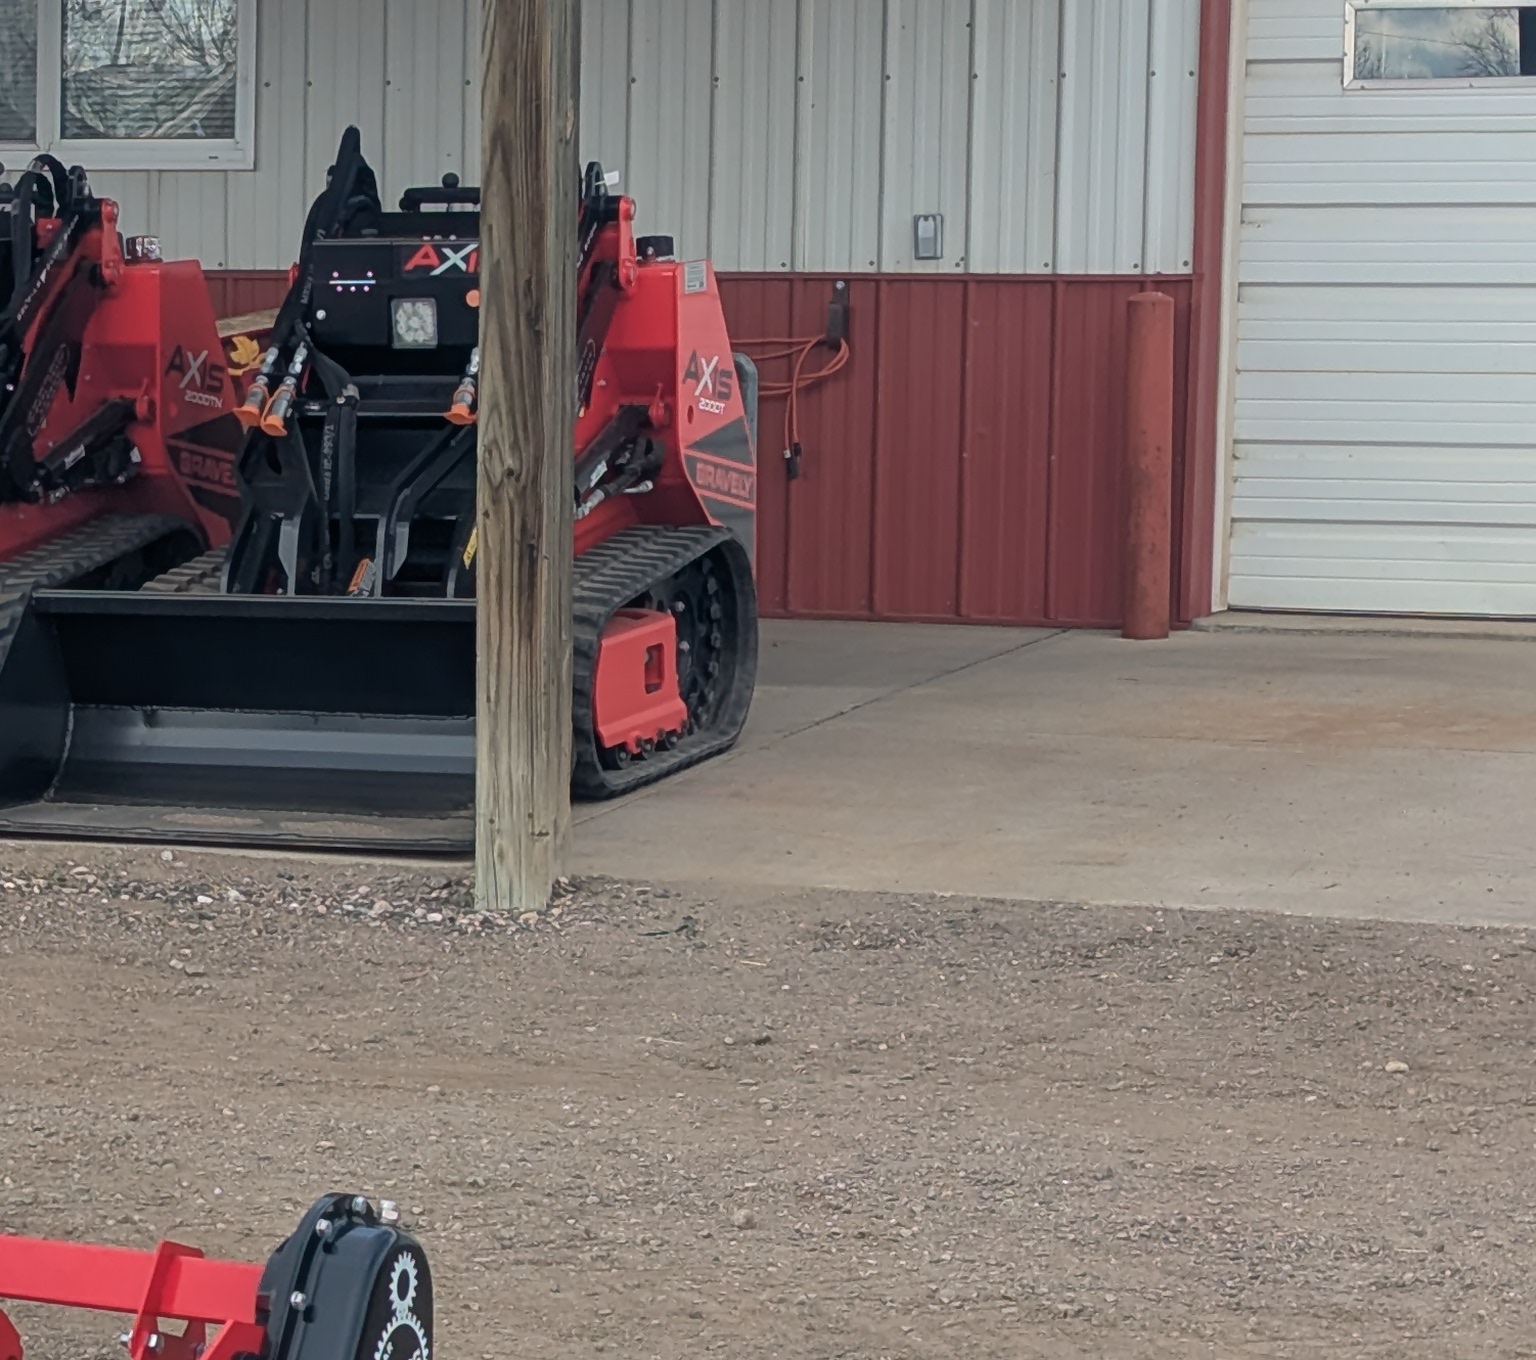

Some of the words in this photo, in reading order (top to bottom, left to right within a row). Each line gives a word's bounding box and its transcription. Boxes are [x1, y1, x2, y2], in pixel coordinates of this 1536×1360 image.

[404, 244, 480, 276] AXI
[165, 344, 225, 394] AXIS
[682, 349, 733, 402] AXIS
[696, 462, 754, 498] GRAVELY
